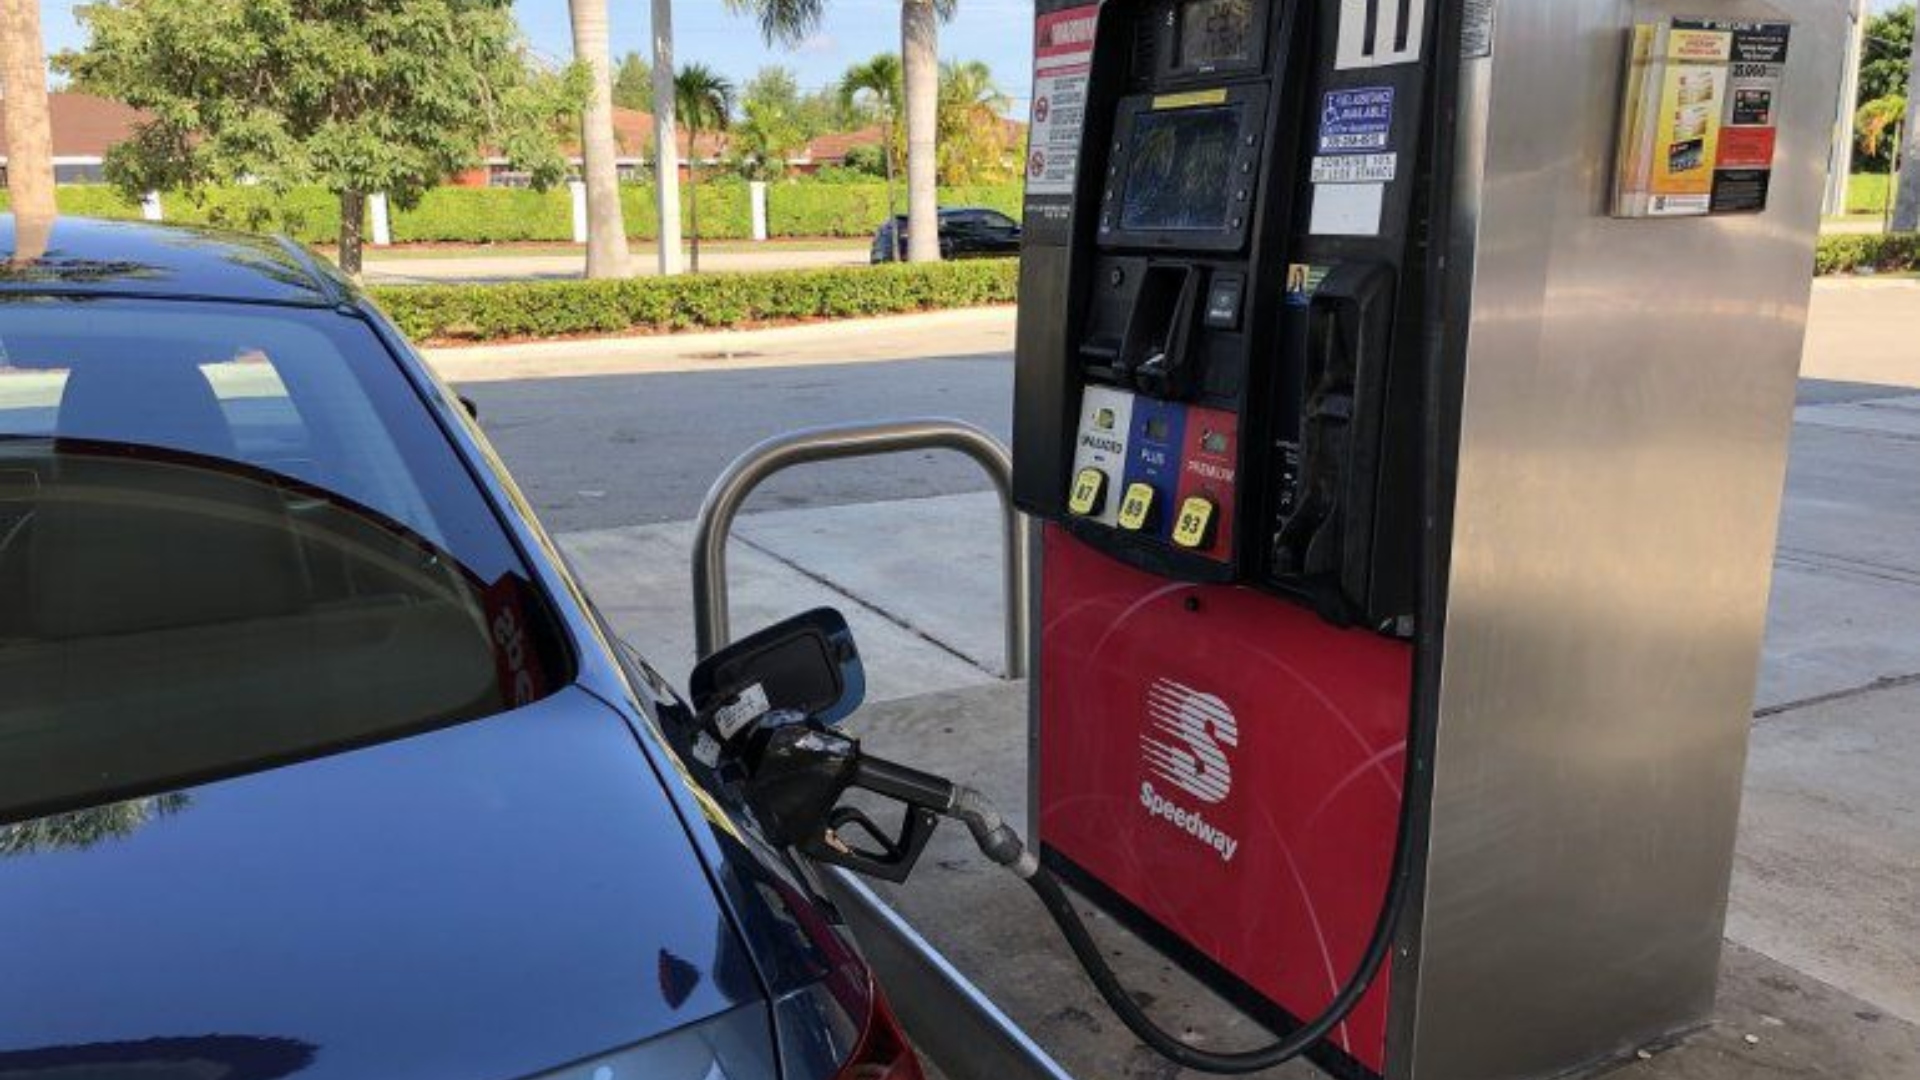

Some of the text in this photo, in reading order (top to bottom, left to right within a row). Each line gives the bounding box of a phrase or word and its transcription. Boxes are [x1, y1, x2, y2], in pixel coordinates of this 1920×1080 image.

[1141, 448, 1166, 466] PLUS
[1187, 460, 1235, 484] PREMIUM
[1076, 483, 1093, 501] 87
[1124, 498, 1143, 517] 89
[1181, 513, 1201, 534] 93
[1140, 781, 1238, 861] Speedway
